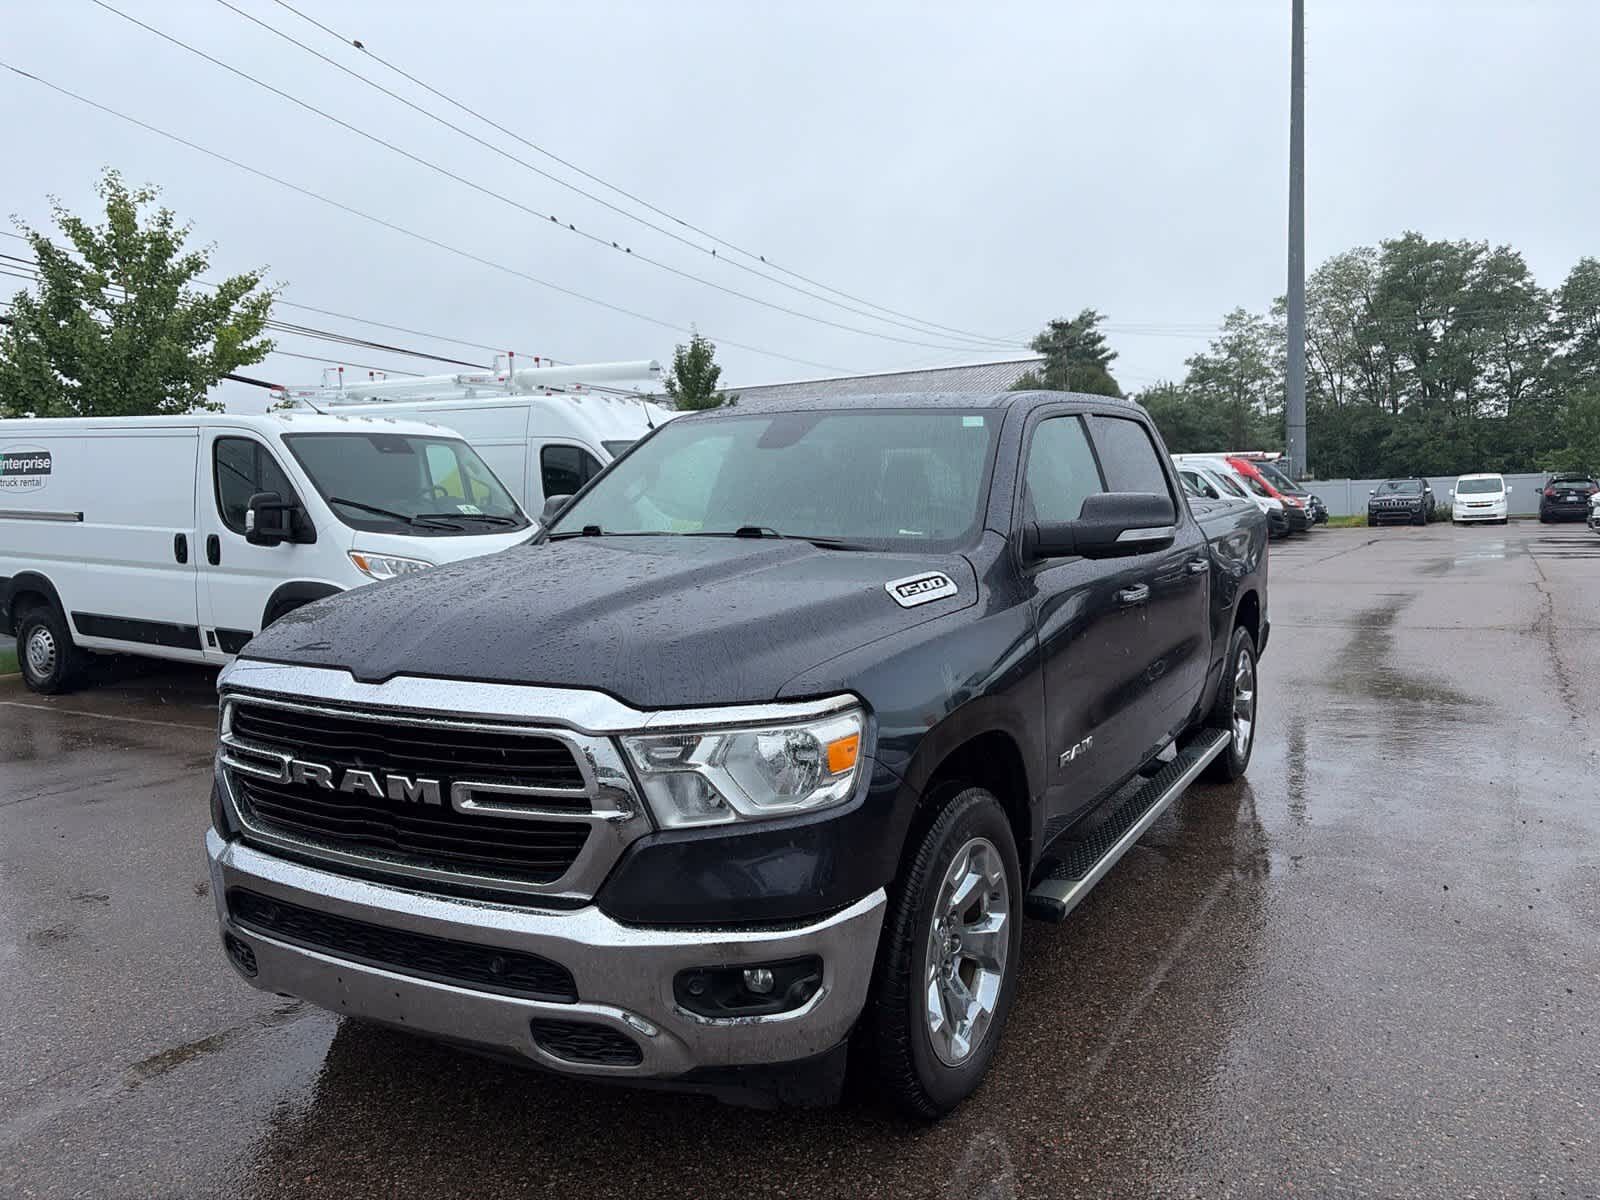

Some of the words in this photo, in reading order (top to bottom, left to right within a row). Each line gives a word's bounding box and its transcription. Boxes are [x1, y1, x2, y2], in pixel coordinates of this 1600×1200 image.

[20, 476, 41, 487] rental
[898, 578, 944, 596] 1500
[1060, 735, 1093, 768] RAM
[291, 760, 442, 805] RAM
